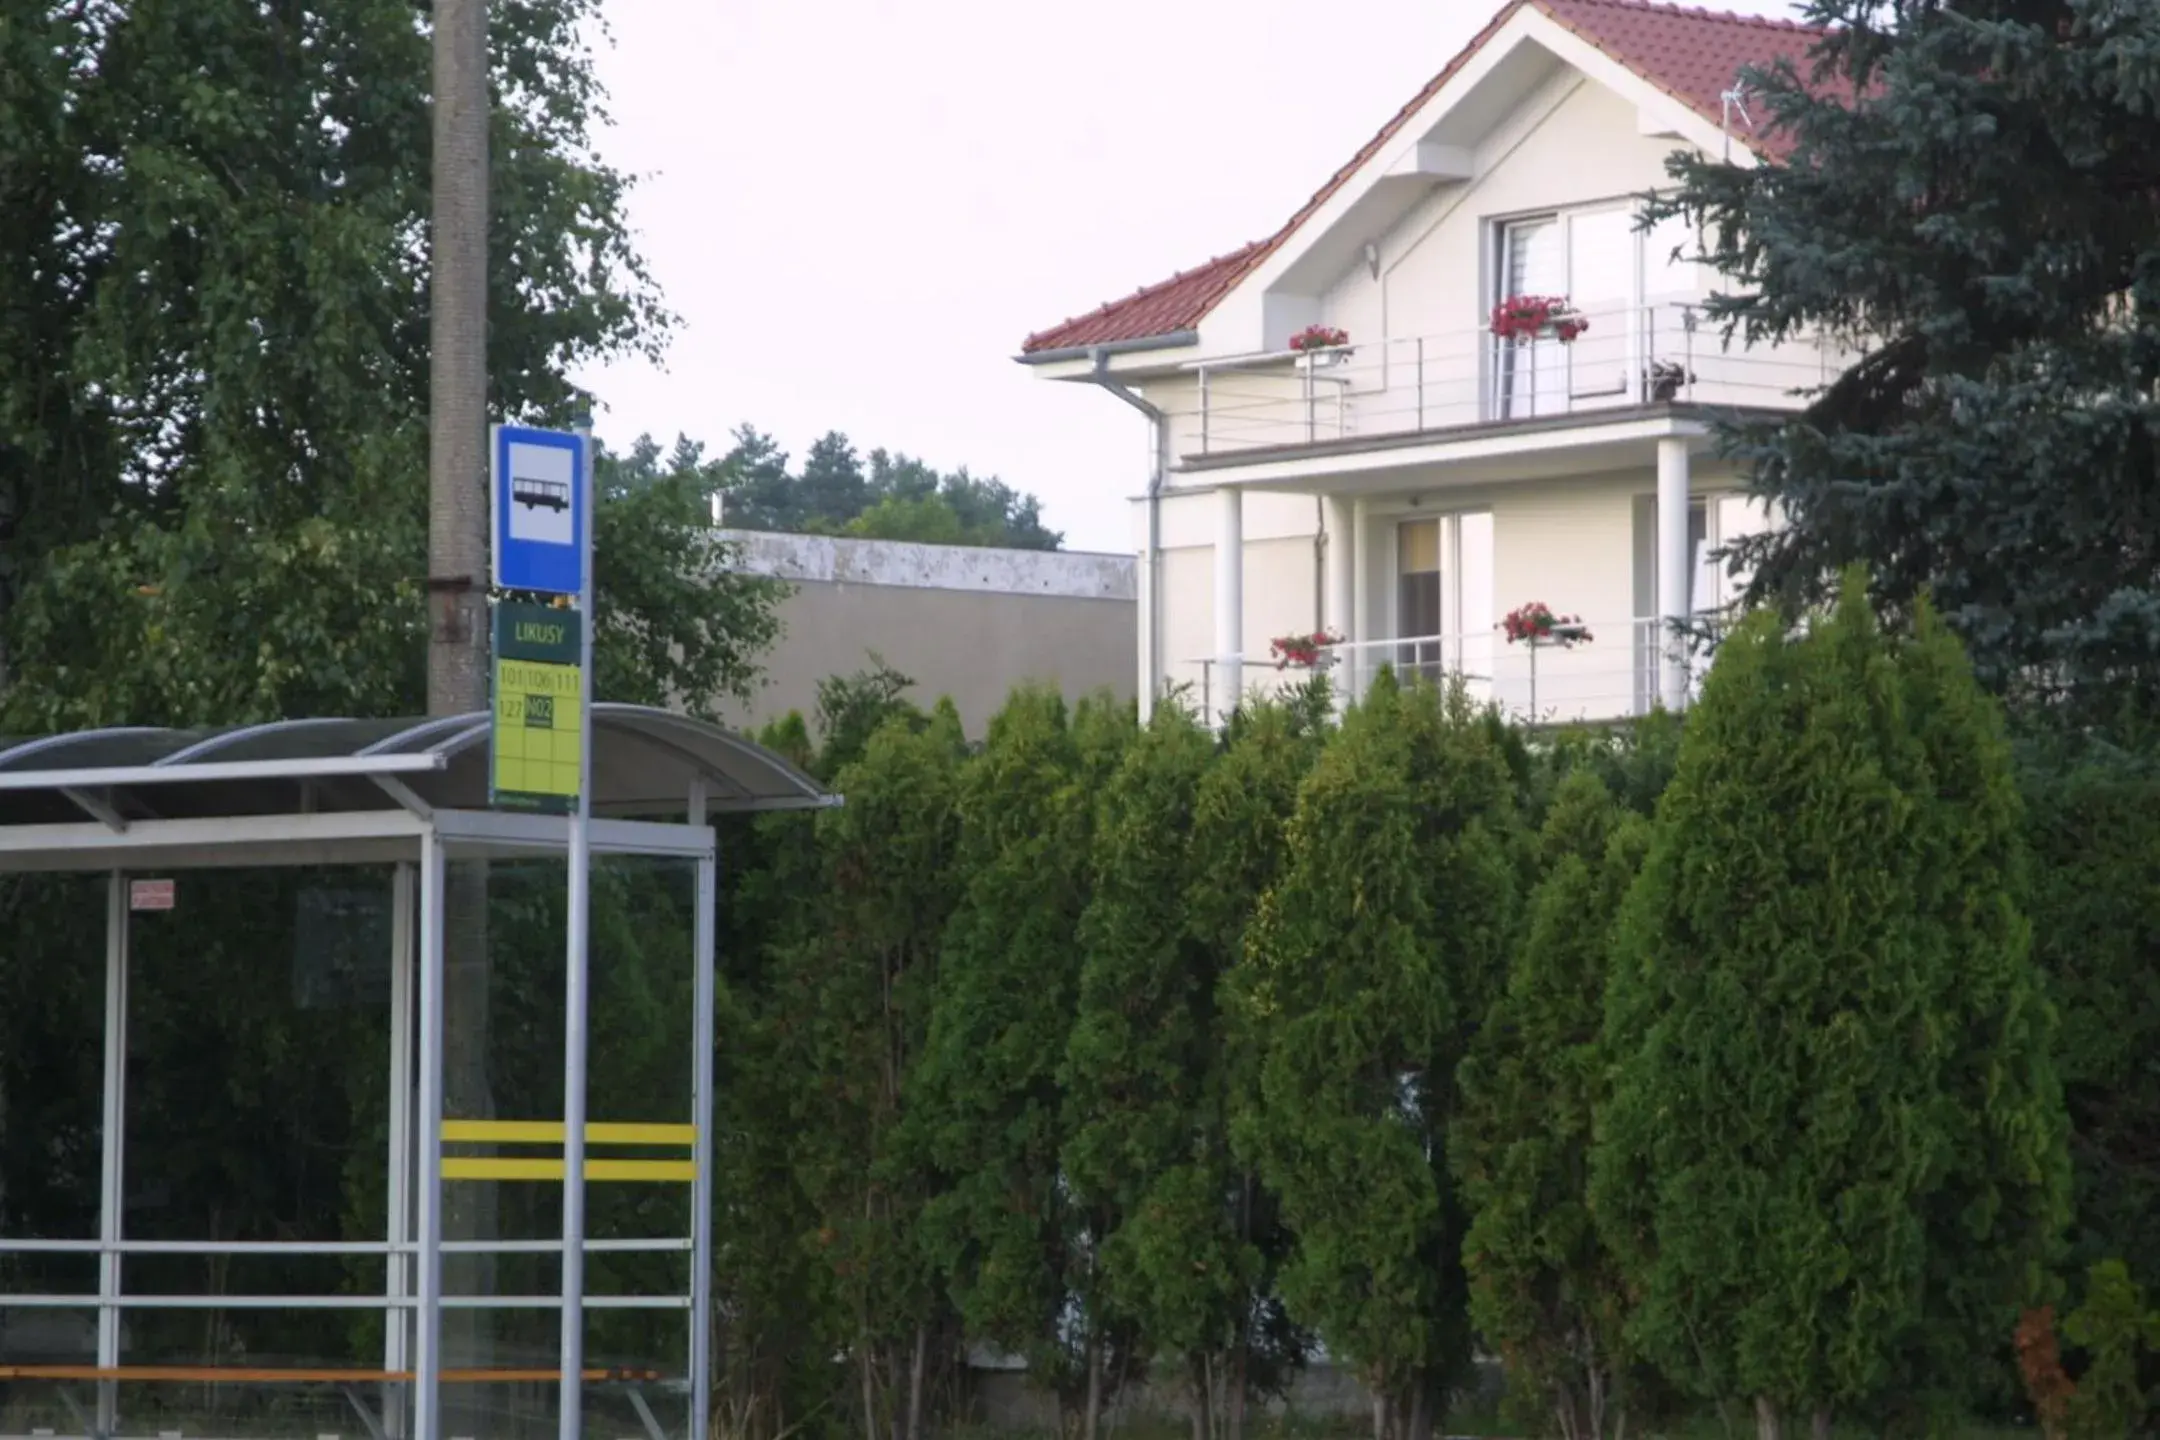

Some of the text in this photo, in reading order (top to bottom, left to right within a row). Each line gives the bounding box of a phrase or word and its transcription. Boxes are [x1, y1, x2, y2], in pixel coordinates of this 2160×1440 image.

[515, 621, 565, 643] LIKUSY
[501, 665, 522, 685] 101
[557, 672, 579, 692] 111
[501, 700, 522, 718] 127
